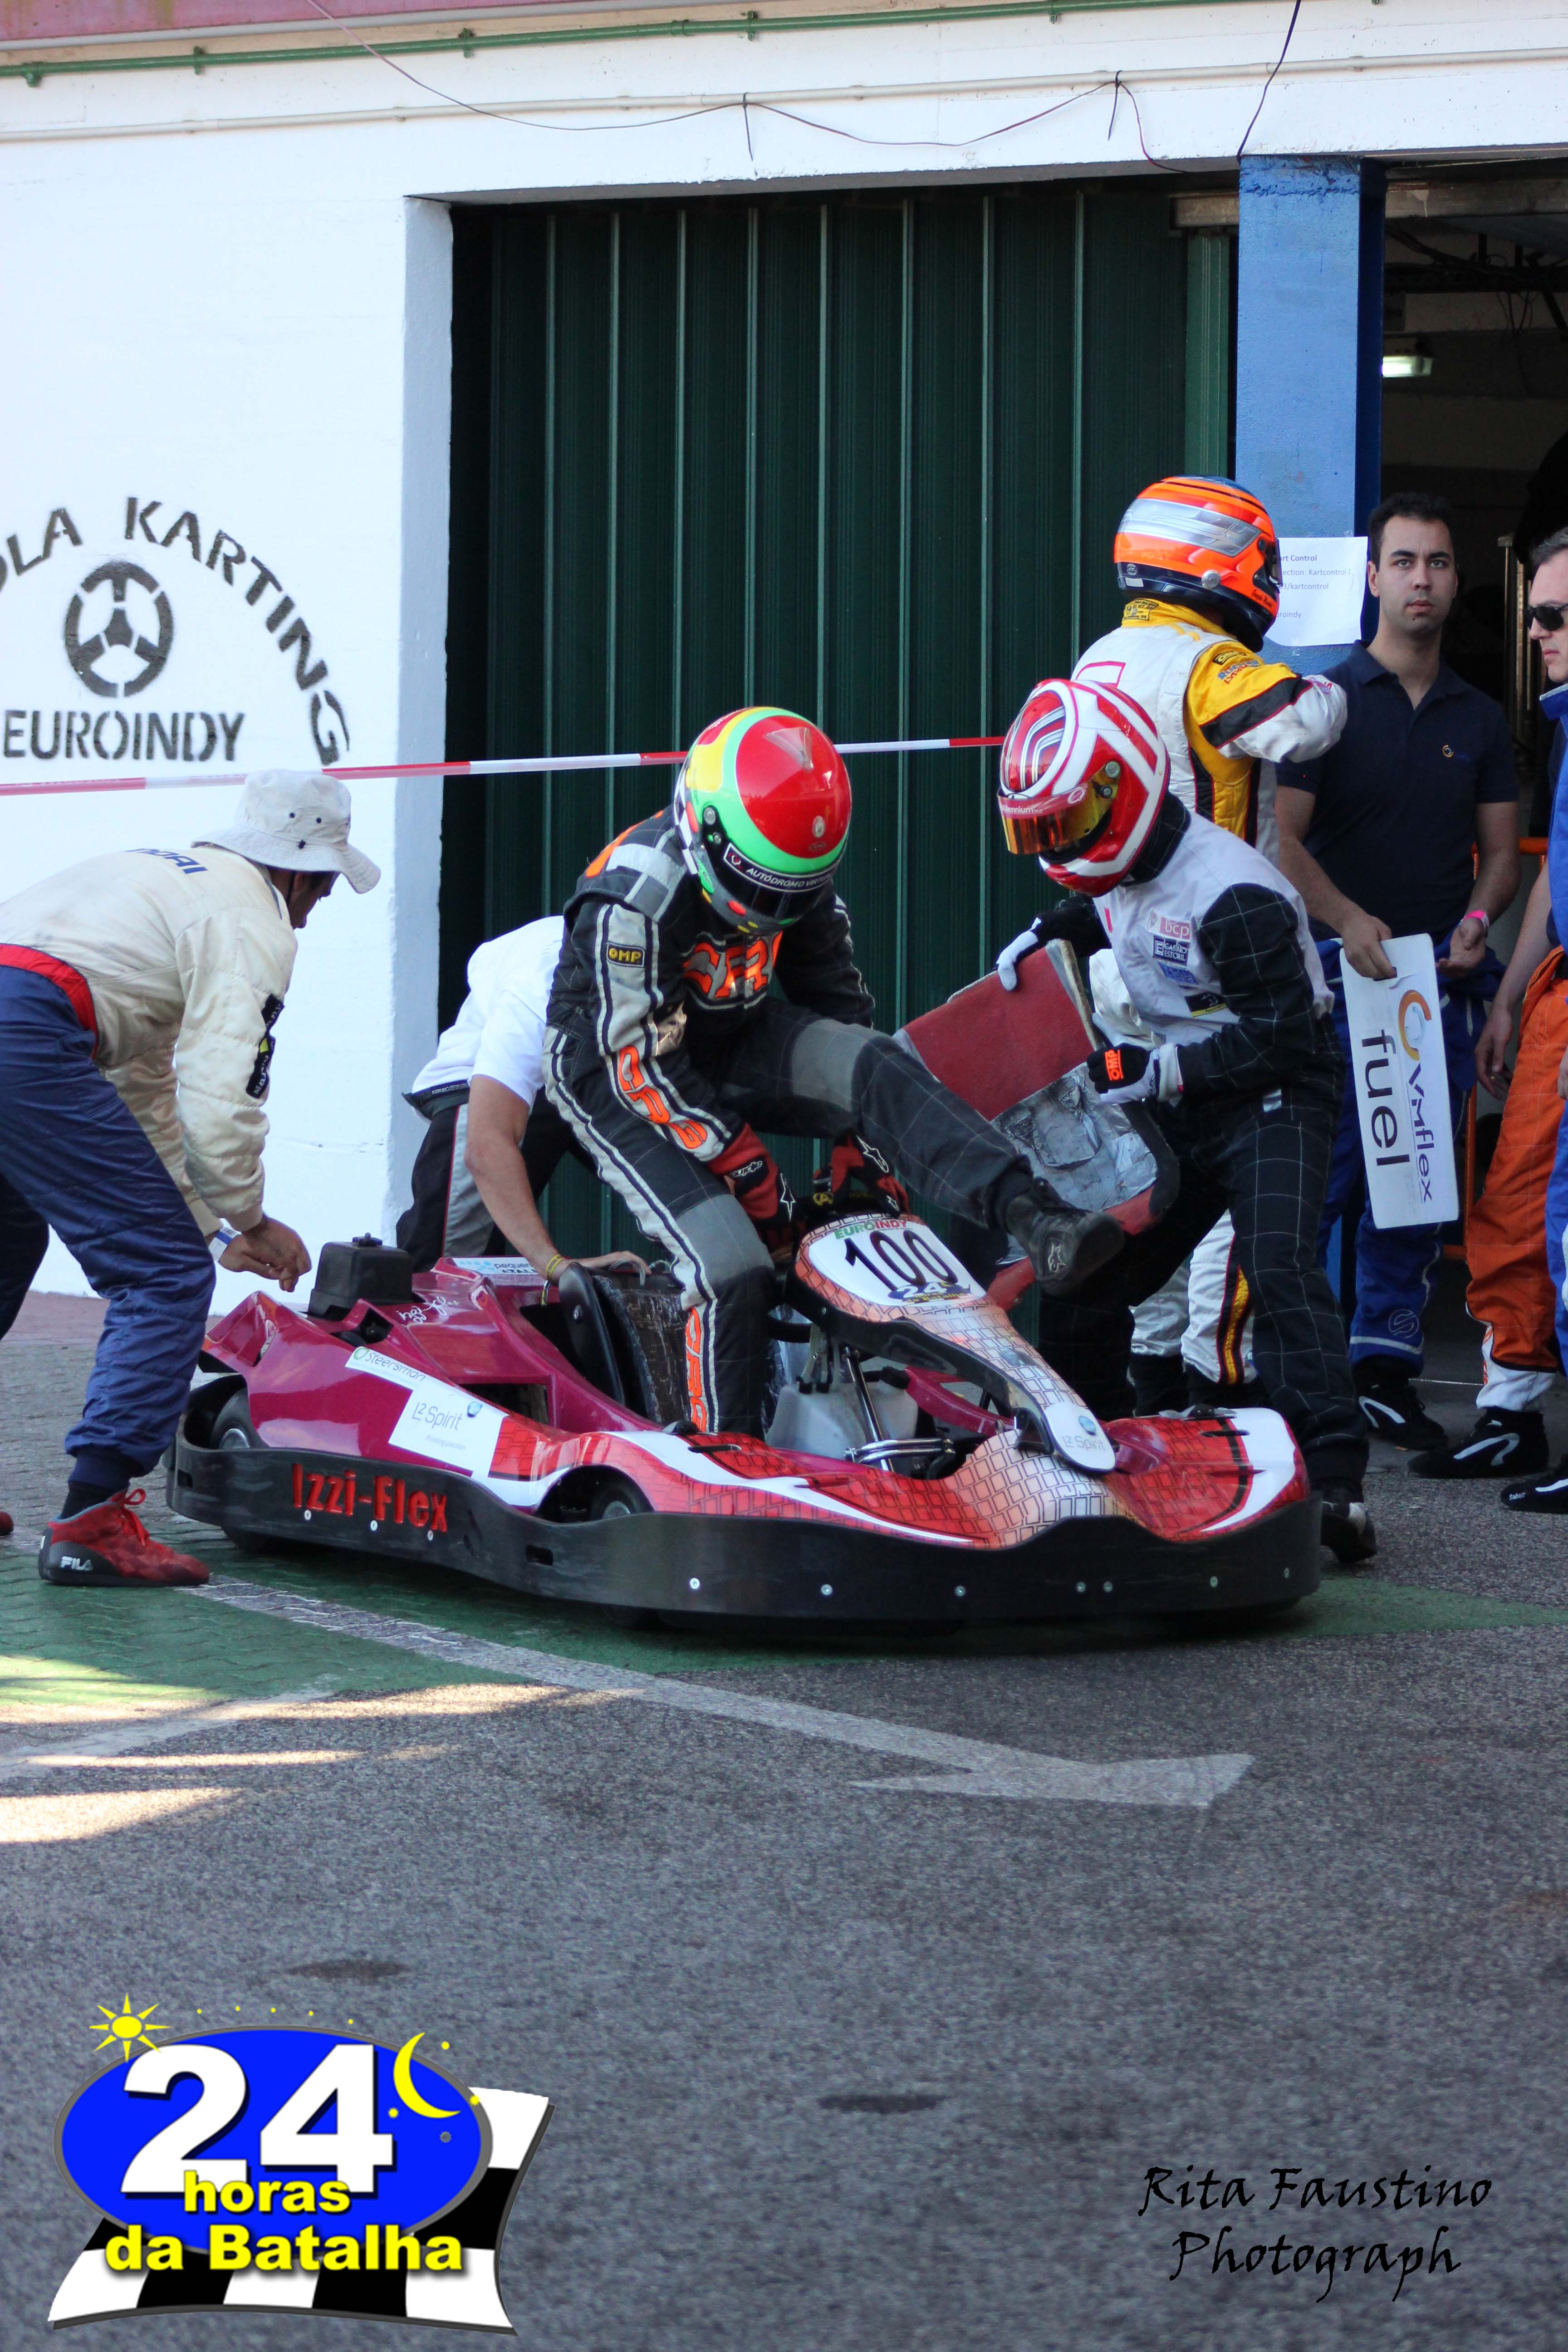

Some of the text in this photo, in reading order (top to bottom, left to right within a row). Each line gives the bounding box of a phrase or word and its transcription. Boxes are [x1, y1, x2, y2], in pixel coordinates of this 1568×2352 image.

[0, 497, 350, 765] LA KARTING
[3, 710, 245, 762] EUROINDY
[746, 867, 805, 887] AUTÓDROMO
[1165, 918, 1189, 938] bcp
[608, 947, 641, 963] OMP
[1164, 942, 1187, 954] CASINO
[1164, 950, 1186, 961] ESTORIL
[682, 930, 784, 998] CR
[1107, 1049, 1121, 1081] OMP
[1362, 1029, 1410, 1166] fuel
[834, 1219, 908, 1240] EUROINDY
[844, 1230, 958, 1292] 100
[897, 1282, 948, 1298] 24
[425, 1406, 463, 1431] Spirit
[425, 1435, 446, 1447] Printing
[1074, 1435, 1107, 1451] Spirit
[292, 1463, 448, 1533] Izzi-Flex
[60, 1555, 93, 1572] FILA
